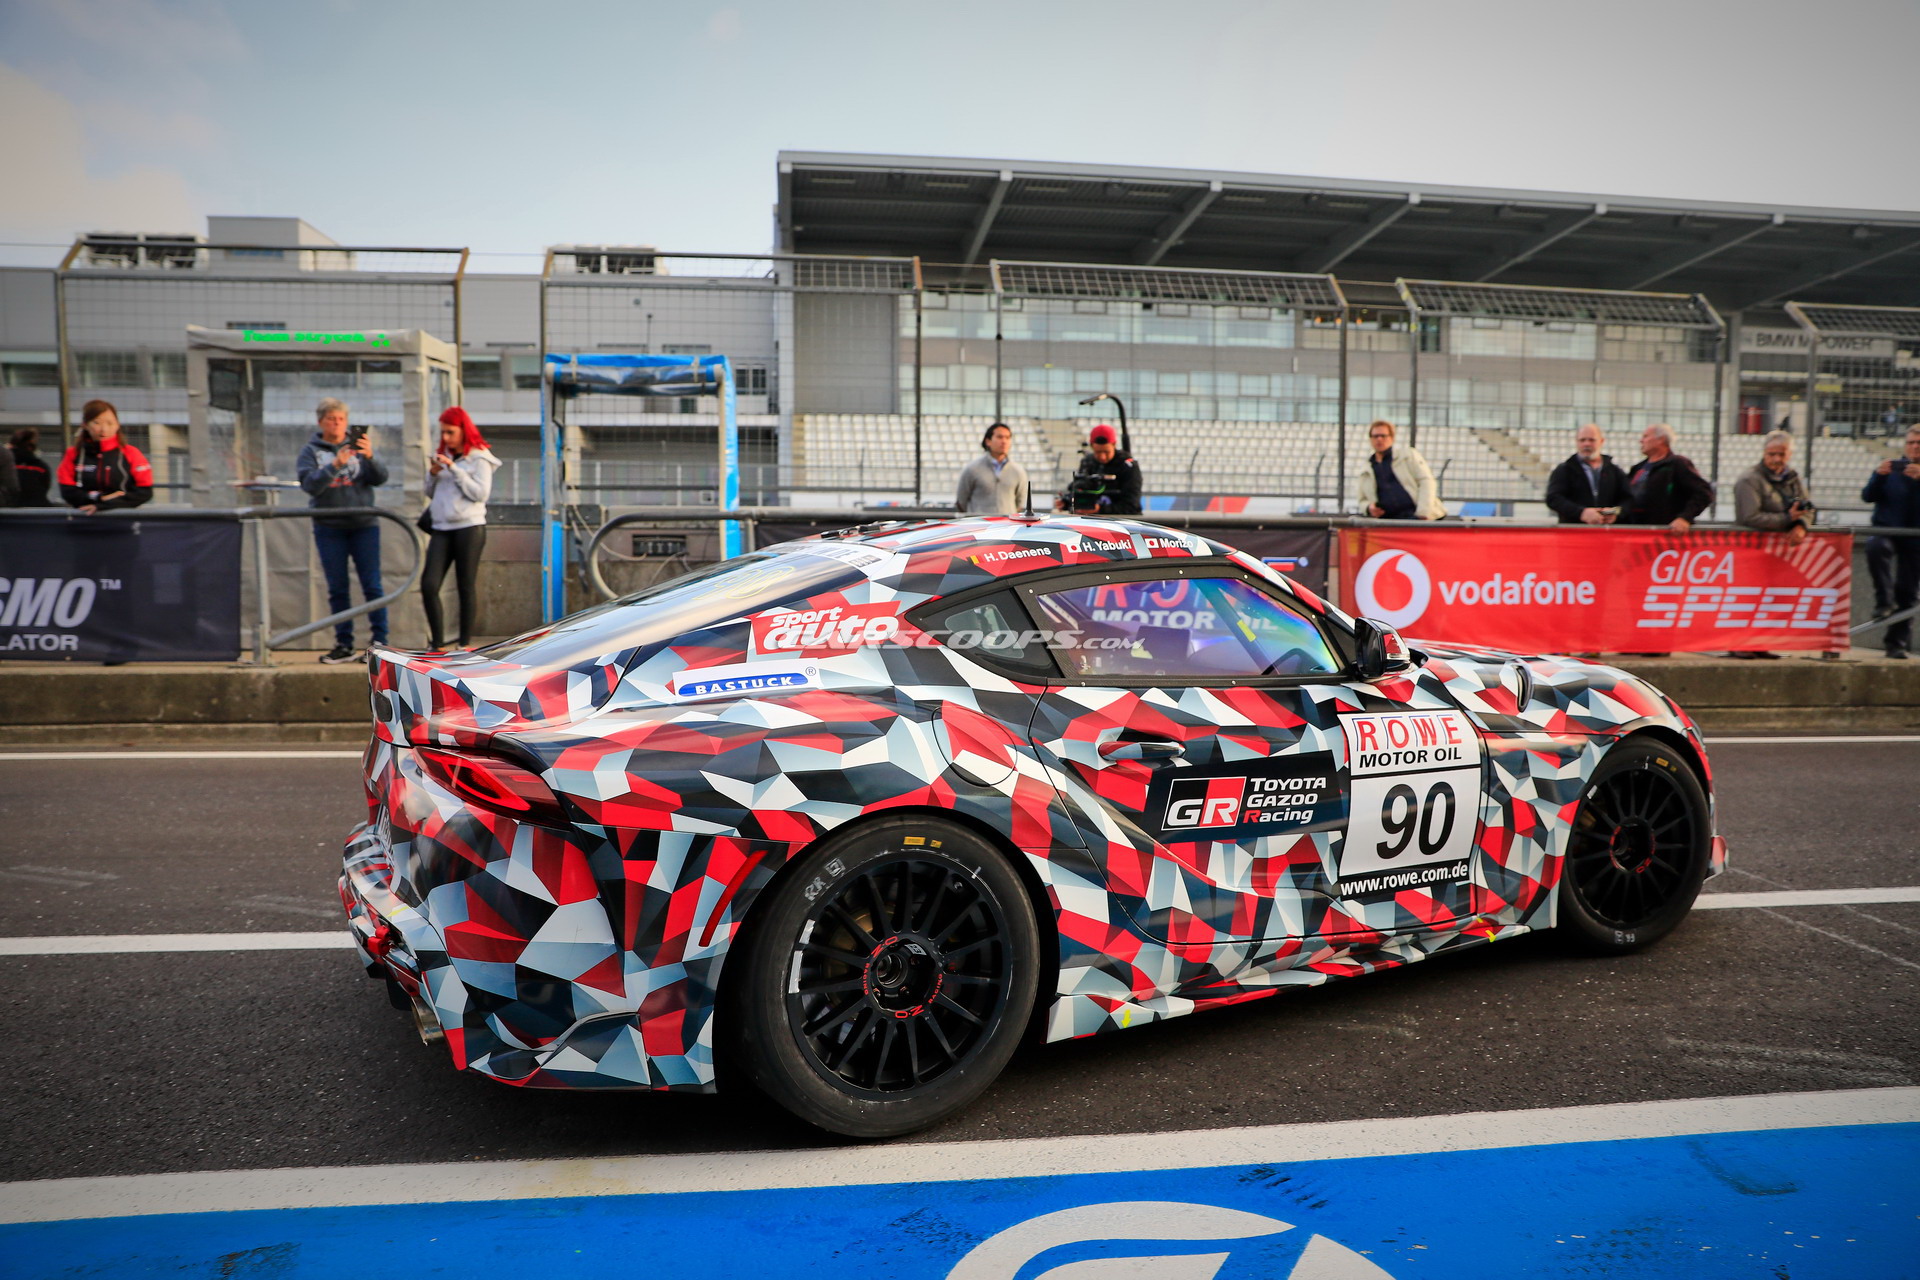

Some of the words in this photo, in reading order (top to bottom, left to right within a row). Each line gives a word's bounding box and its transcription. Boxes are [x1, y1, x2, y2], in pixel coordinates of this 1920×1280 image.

[1756, 332, 1795, 347] BMW
[1082, 541, 1096, 552] H.
[1095, 538, 1132, 551] Yabuki
[1160, 537, 1194, 549] Morizo
[984, 552, 998, 563] H.
[1000, 546, 1052, 561] Daenens
[1651, 550, 1734, 584] GIGA
[1438, 572, 1596, 606] vodafone
[1636, 585, 1840, 628] SPEED
[769, 606, 844, 633] sport
[1091, 609, 1217, 630] MOTOR
[762, 614, 899, 651] auto
[694, 675, 795, 696] BASTUCK
[1352, 714, 1462, 752] ROWE
[1359, 750, 1428, 769] MOTOR
[1434, 747, 1462, 761] OIL
[1250, 776, 1327, 792] TOYOTA
[1167, 797, 1239, 826] GR
[1246, 793, 1318, 808] GAZOO
[1242, 808, 1313, 825] Racing
[1376, 781, 1456, 860] 90
[1340, 860, 1468, 896] www.rowe.com.de
